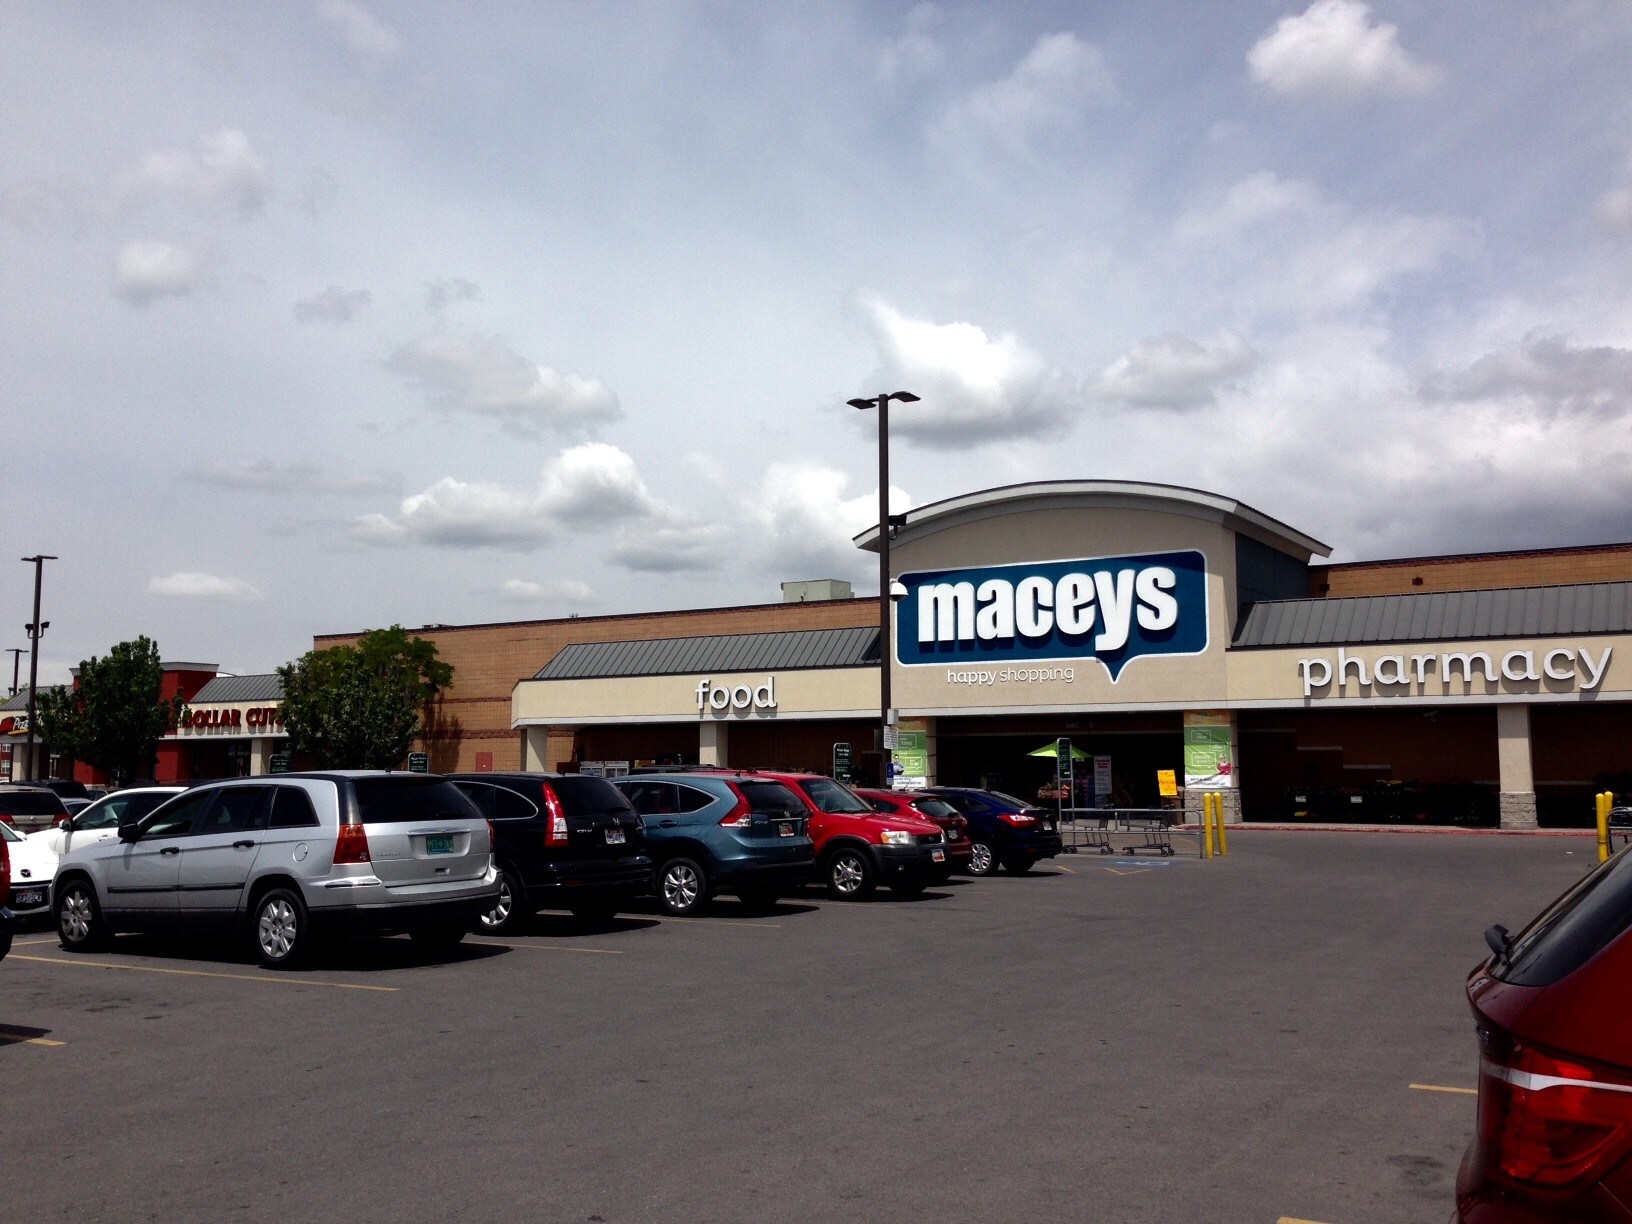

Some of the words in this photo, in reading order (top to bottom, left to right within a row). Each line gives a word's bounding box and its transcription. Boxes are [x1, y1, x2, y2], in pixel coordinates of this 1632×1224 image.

[918, 566, 1178, 651] maceys
[947, 669, 997, 686] happy
[999, 667, 1074, 684] shopping
[1298, 647, 1612, 696] pharmacy
[694, 676, 777, 709] food
